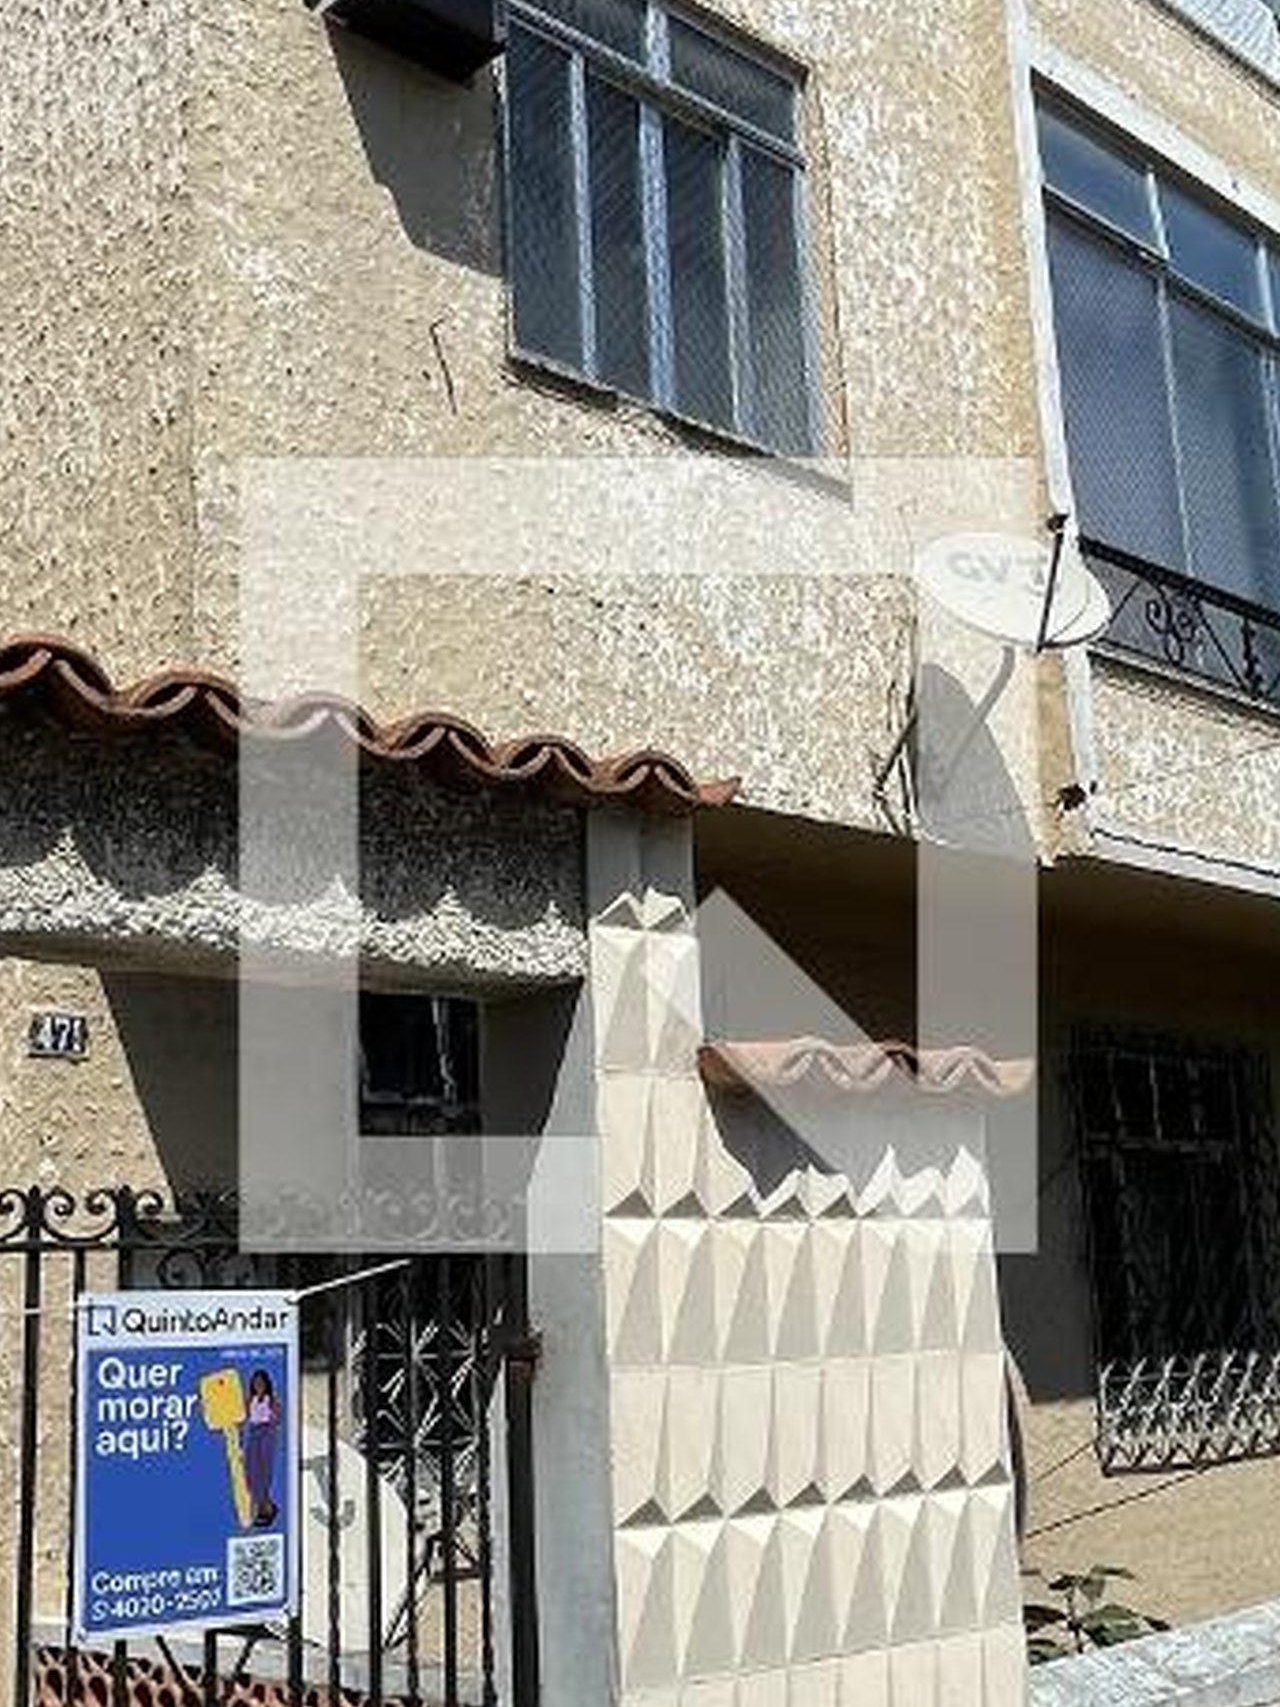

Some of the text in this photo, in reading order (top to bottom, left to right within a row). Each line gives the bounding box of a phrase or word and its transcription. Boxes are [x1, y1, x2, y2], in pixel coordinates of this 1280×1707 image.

[123, 1306, 289, 1336] QuintoAndar
[99, 1356, 183, 1390] Quer
[98, 1393, 198, 1423] morar
[95, 1419, 189, 1461] aqui?
[91, 1569, 182, 1595] Compre
